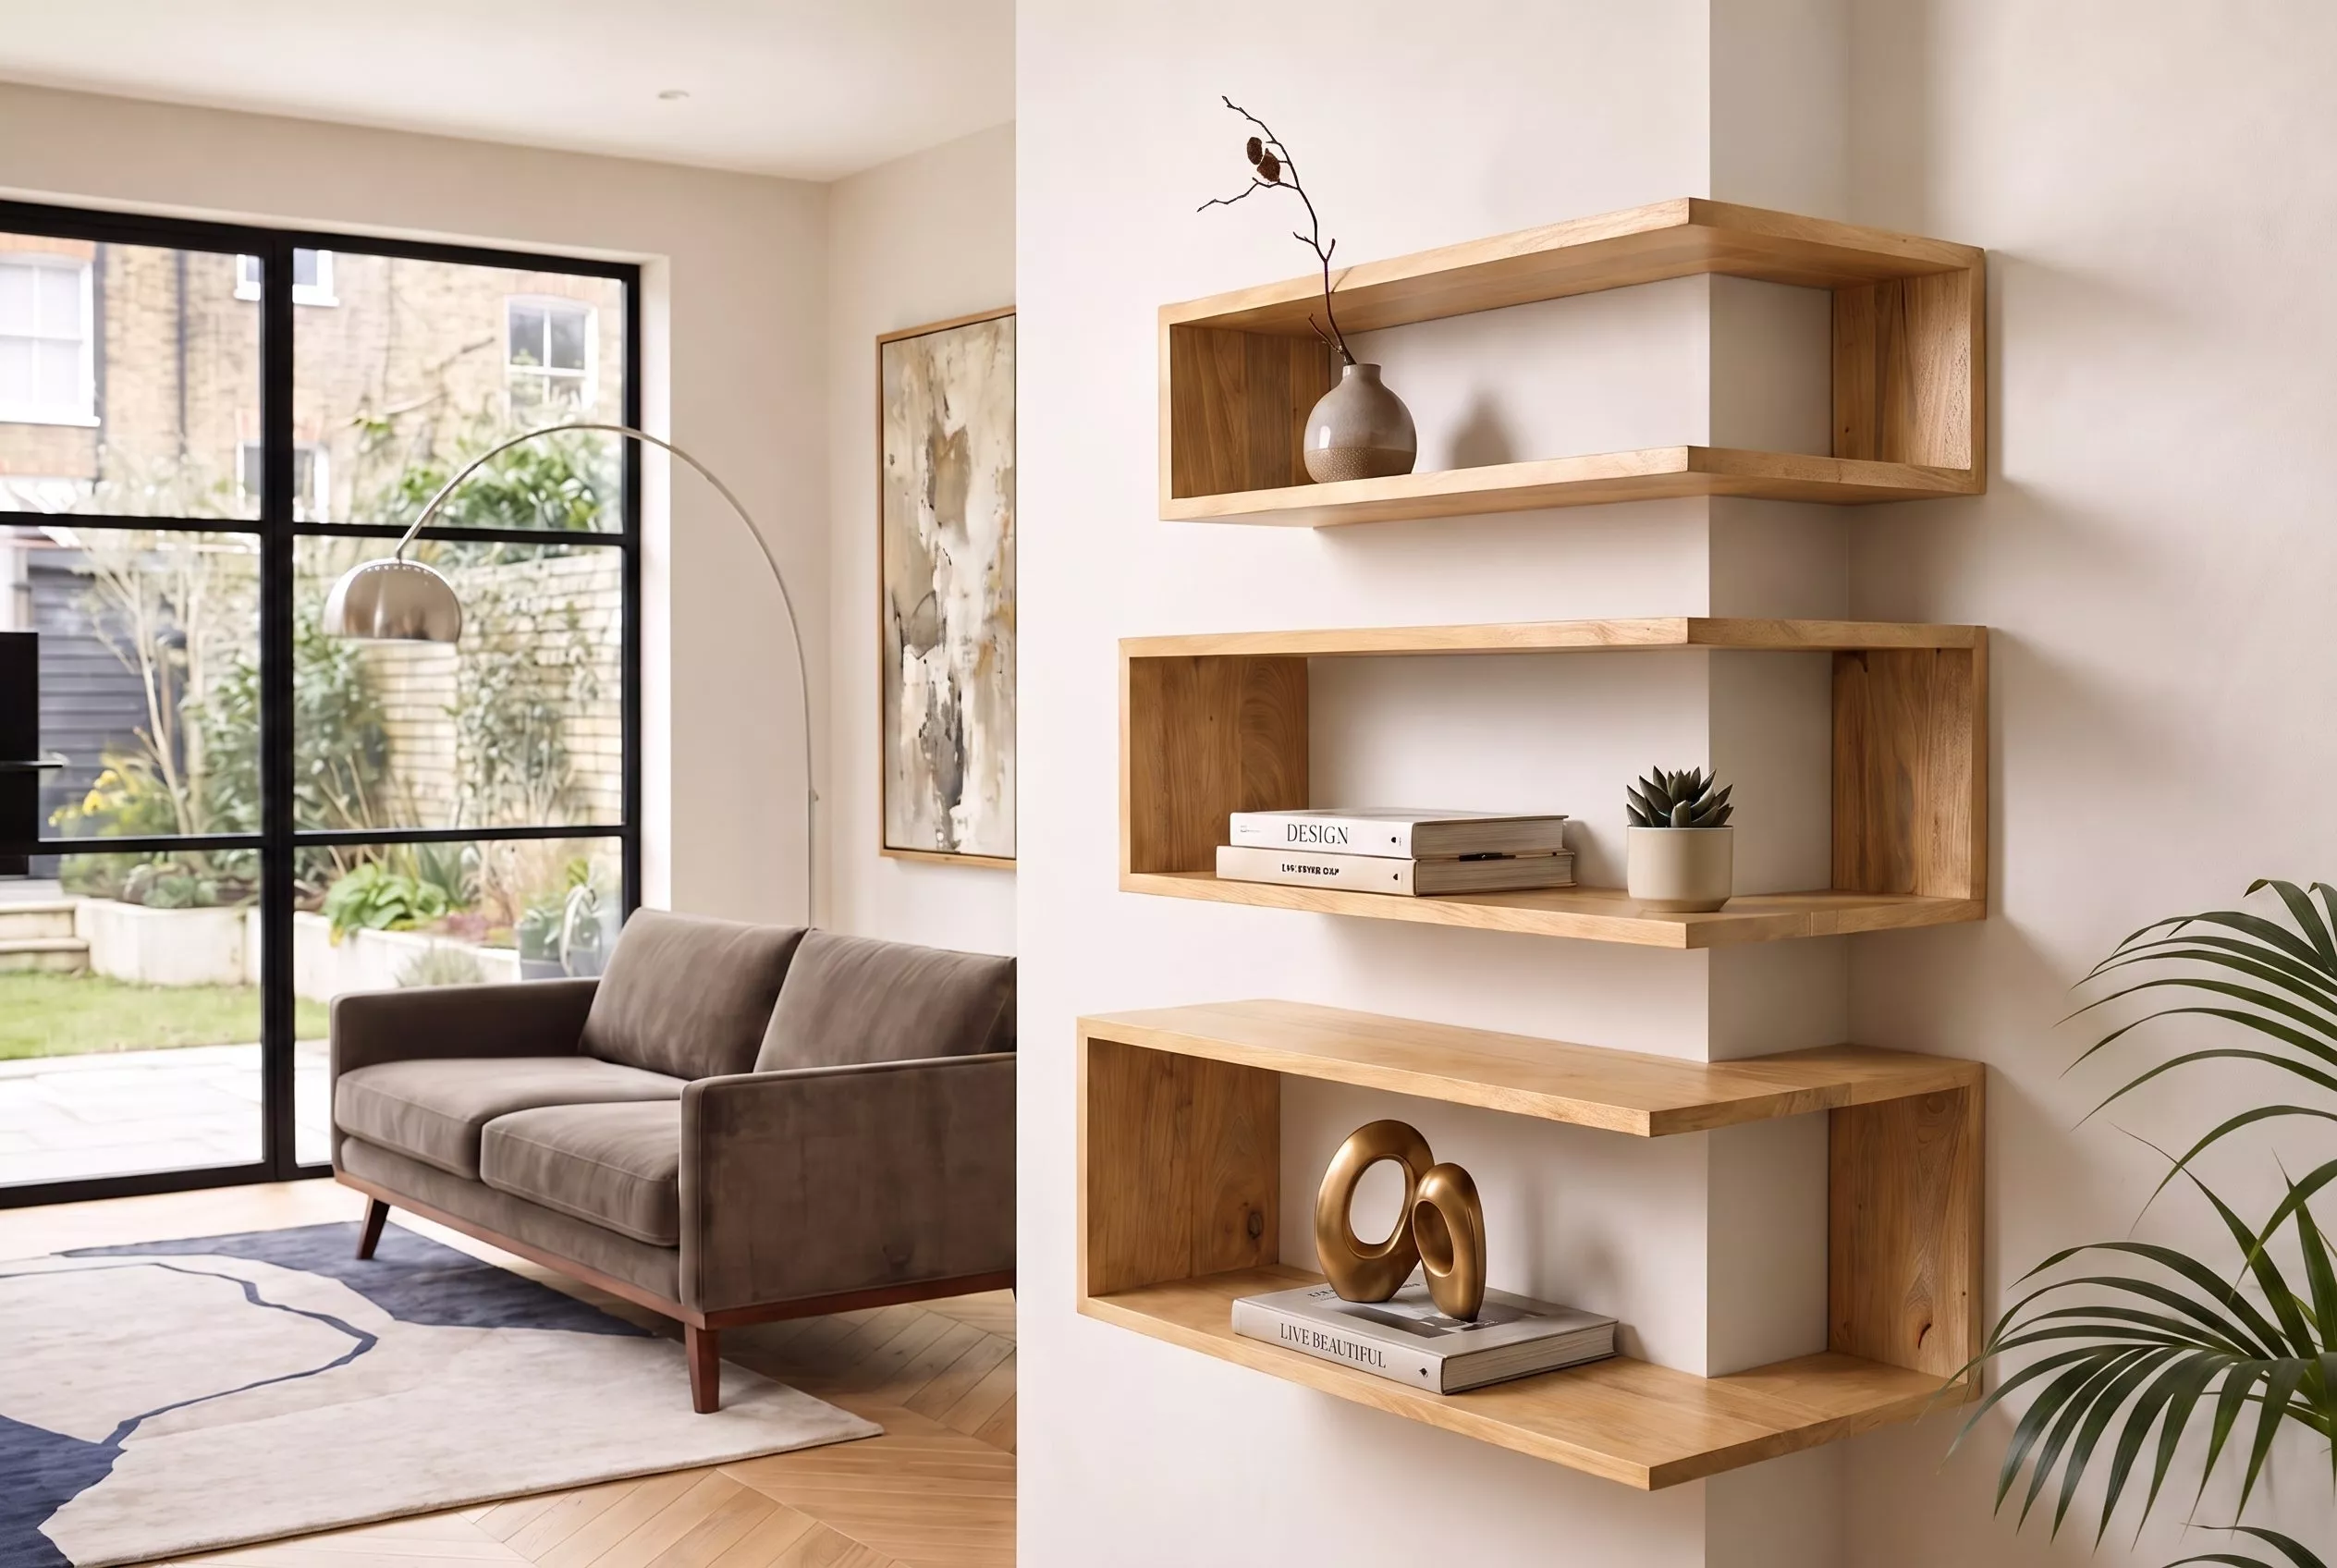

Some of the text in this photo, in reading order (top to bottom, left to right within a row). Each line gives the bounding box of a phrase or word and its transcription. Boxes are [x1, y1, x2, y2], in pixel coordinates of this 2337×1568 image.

[1287, 824, 1349, 844] DESIGN
[1280, 1323, 1387, 1368] LIVE BEAUTIFUL
